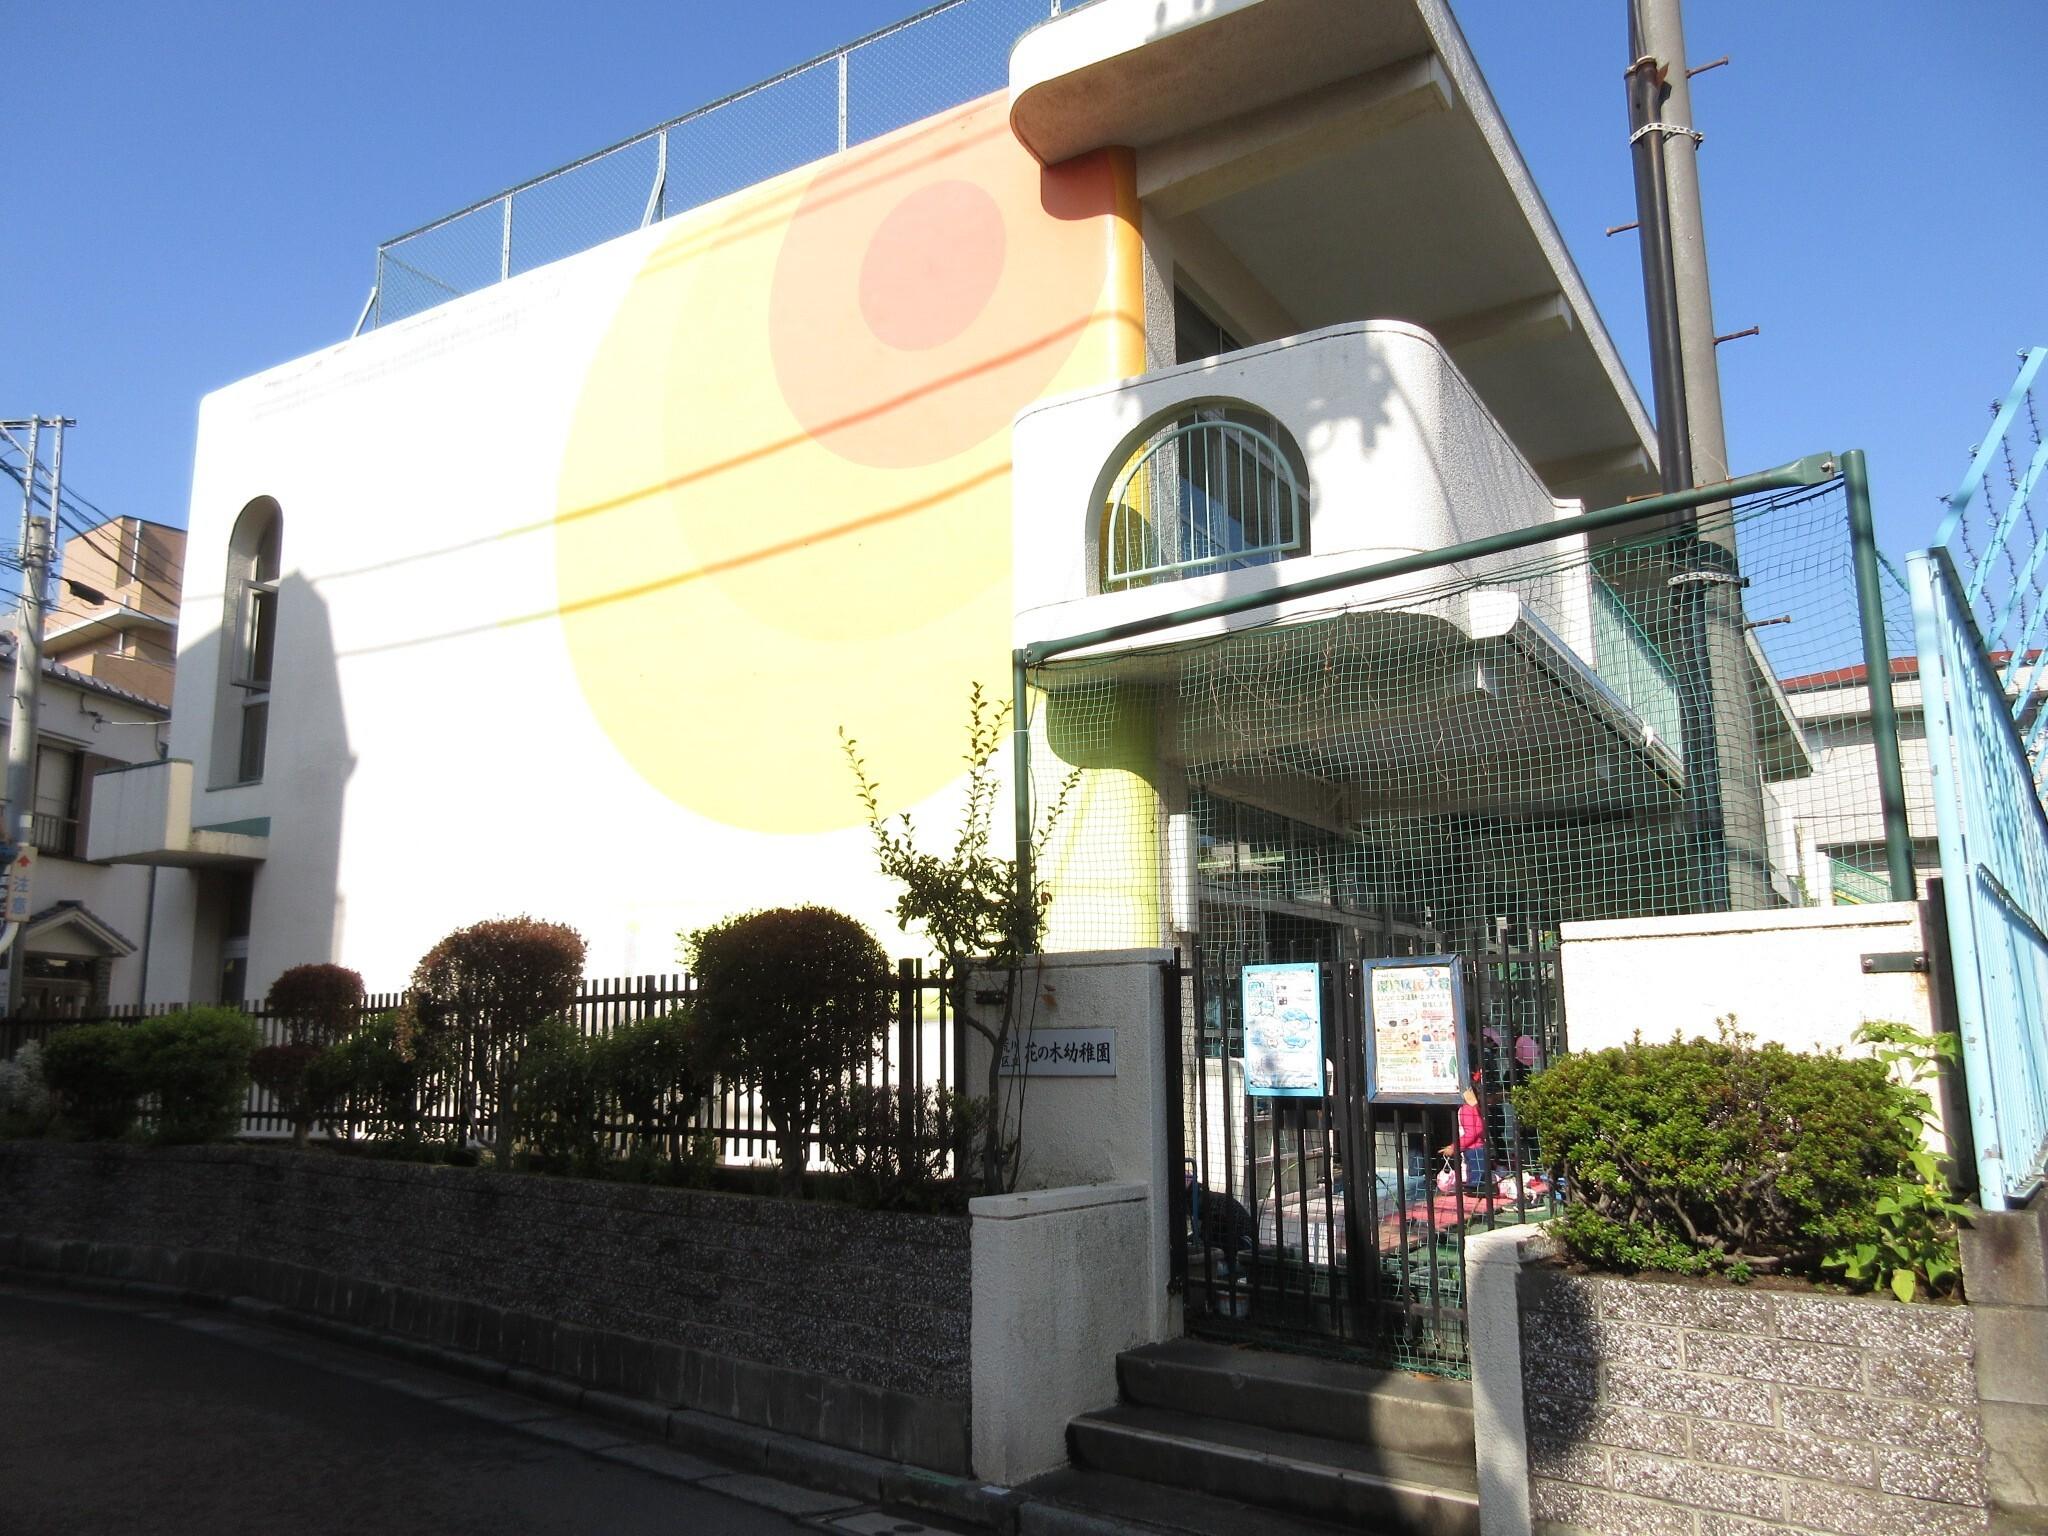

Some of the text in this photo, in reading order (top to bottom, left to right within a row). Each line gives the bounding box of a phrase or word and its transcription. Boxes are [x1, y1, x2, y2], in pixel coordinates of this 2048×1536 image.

[1024, 1041, 1110, 1064] 花の木幼稚園
